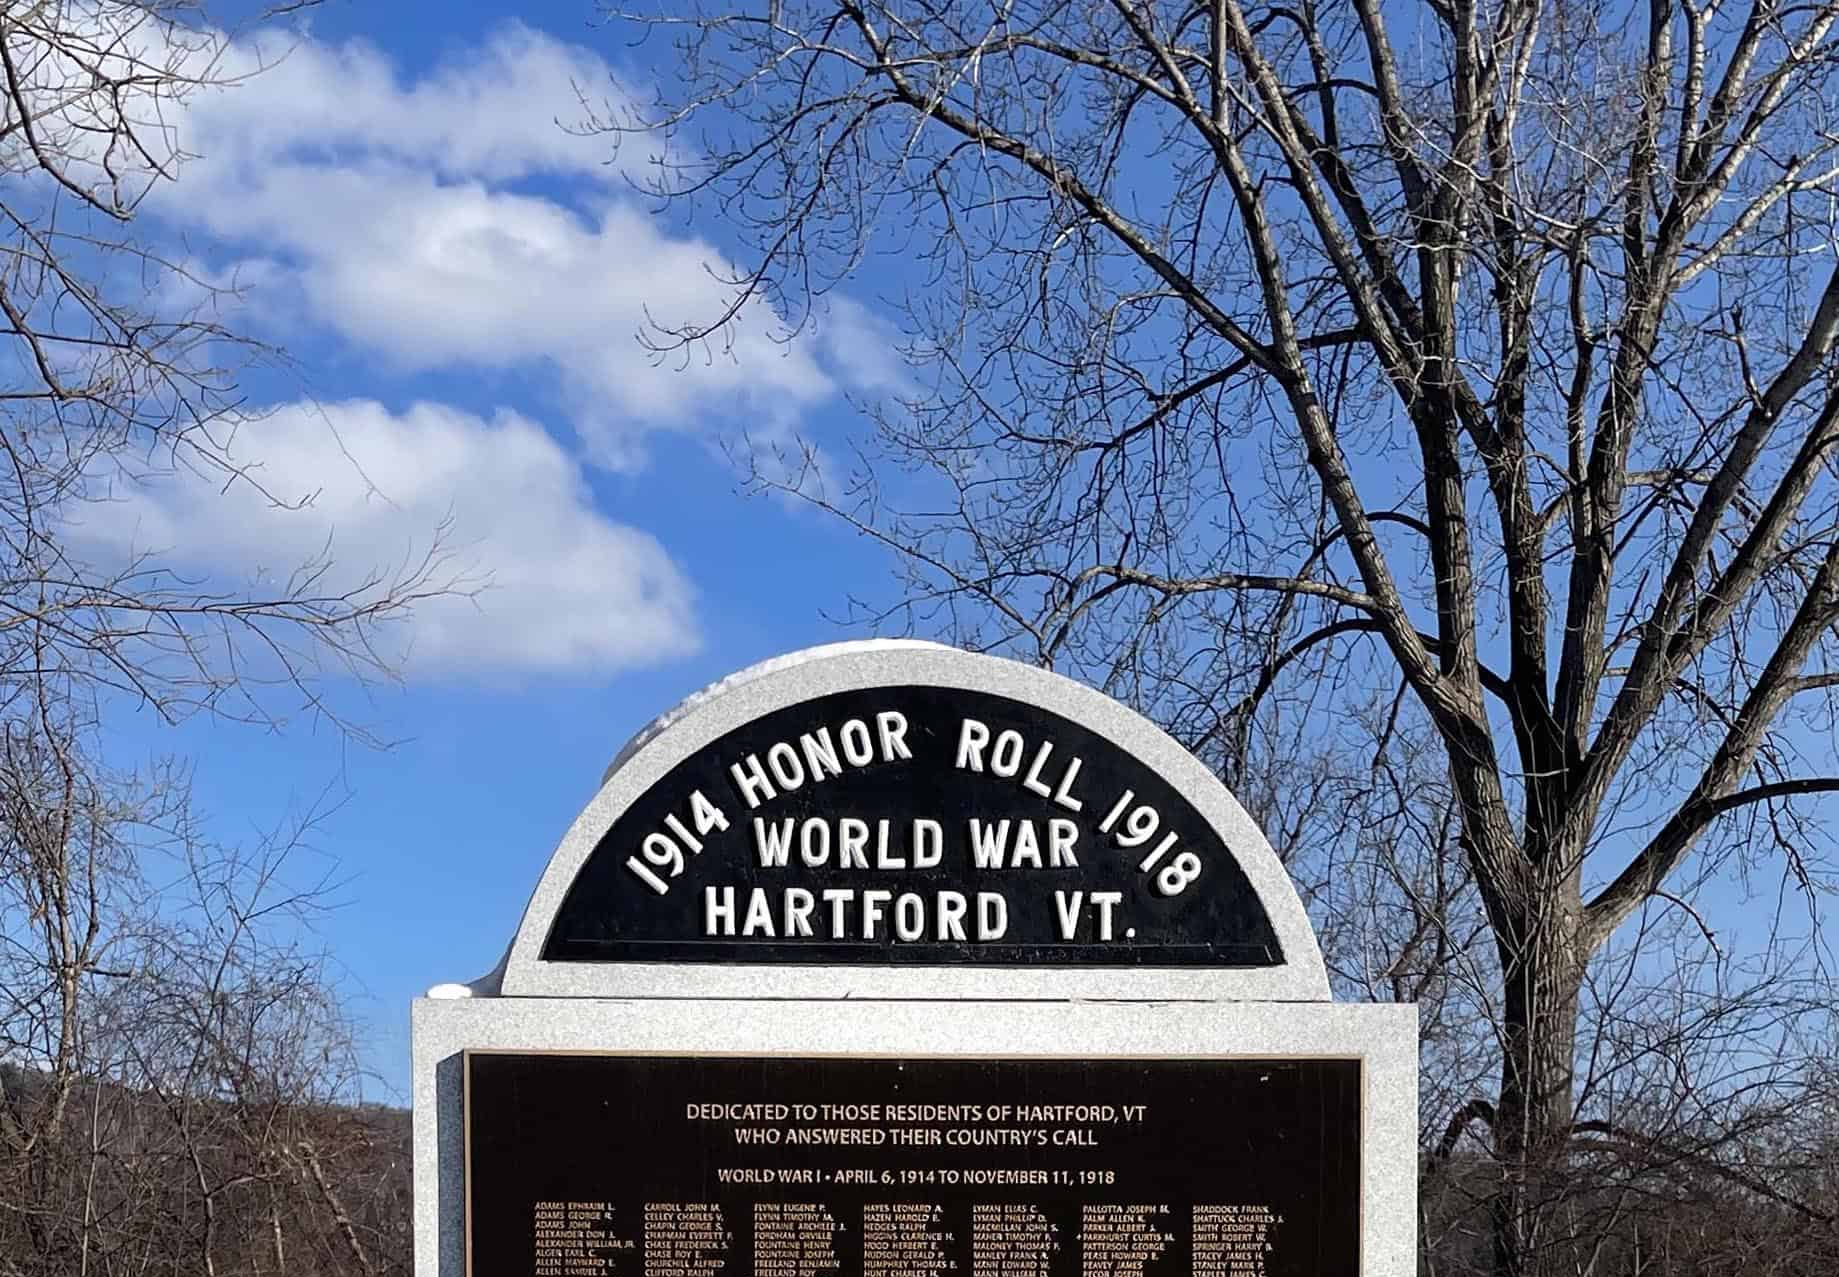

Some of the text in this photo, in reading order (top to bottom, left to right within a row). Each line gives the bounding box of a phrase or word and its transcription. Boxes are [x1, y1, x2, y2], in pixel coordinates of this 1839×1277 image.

[627, 712, 1201, 894] 1914 HONOR ROLL 1918
[755, 818, 1078, 869] WORLD WAR
[706, 887, 1136, 941] HARTFORD VT.
[687, 1104, 1147, 1123] DEDICATED TO THOSE RESIDENTS OF HARTFORD, VT
[735, 1129, 1098, 1145] WHO ANSWERED THEIR COUNTRY'S CALL
[718, 1169, 1115, 1186] WORLD WAR I APRIL 6, 1914 TO NOVEMBER 11, 1918
